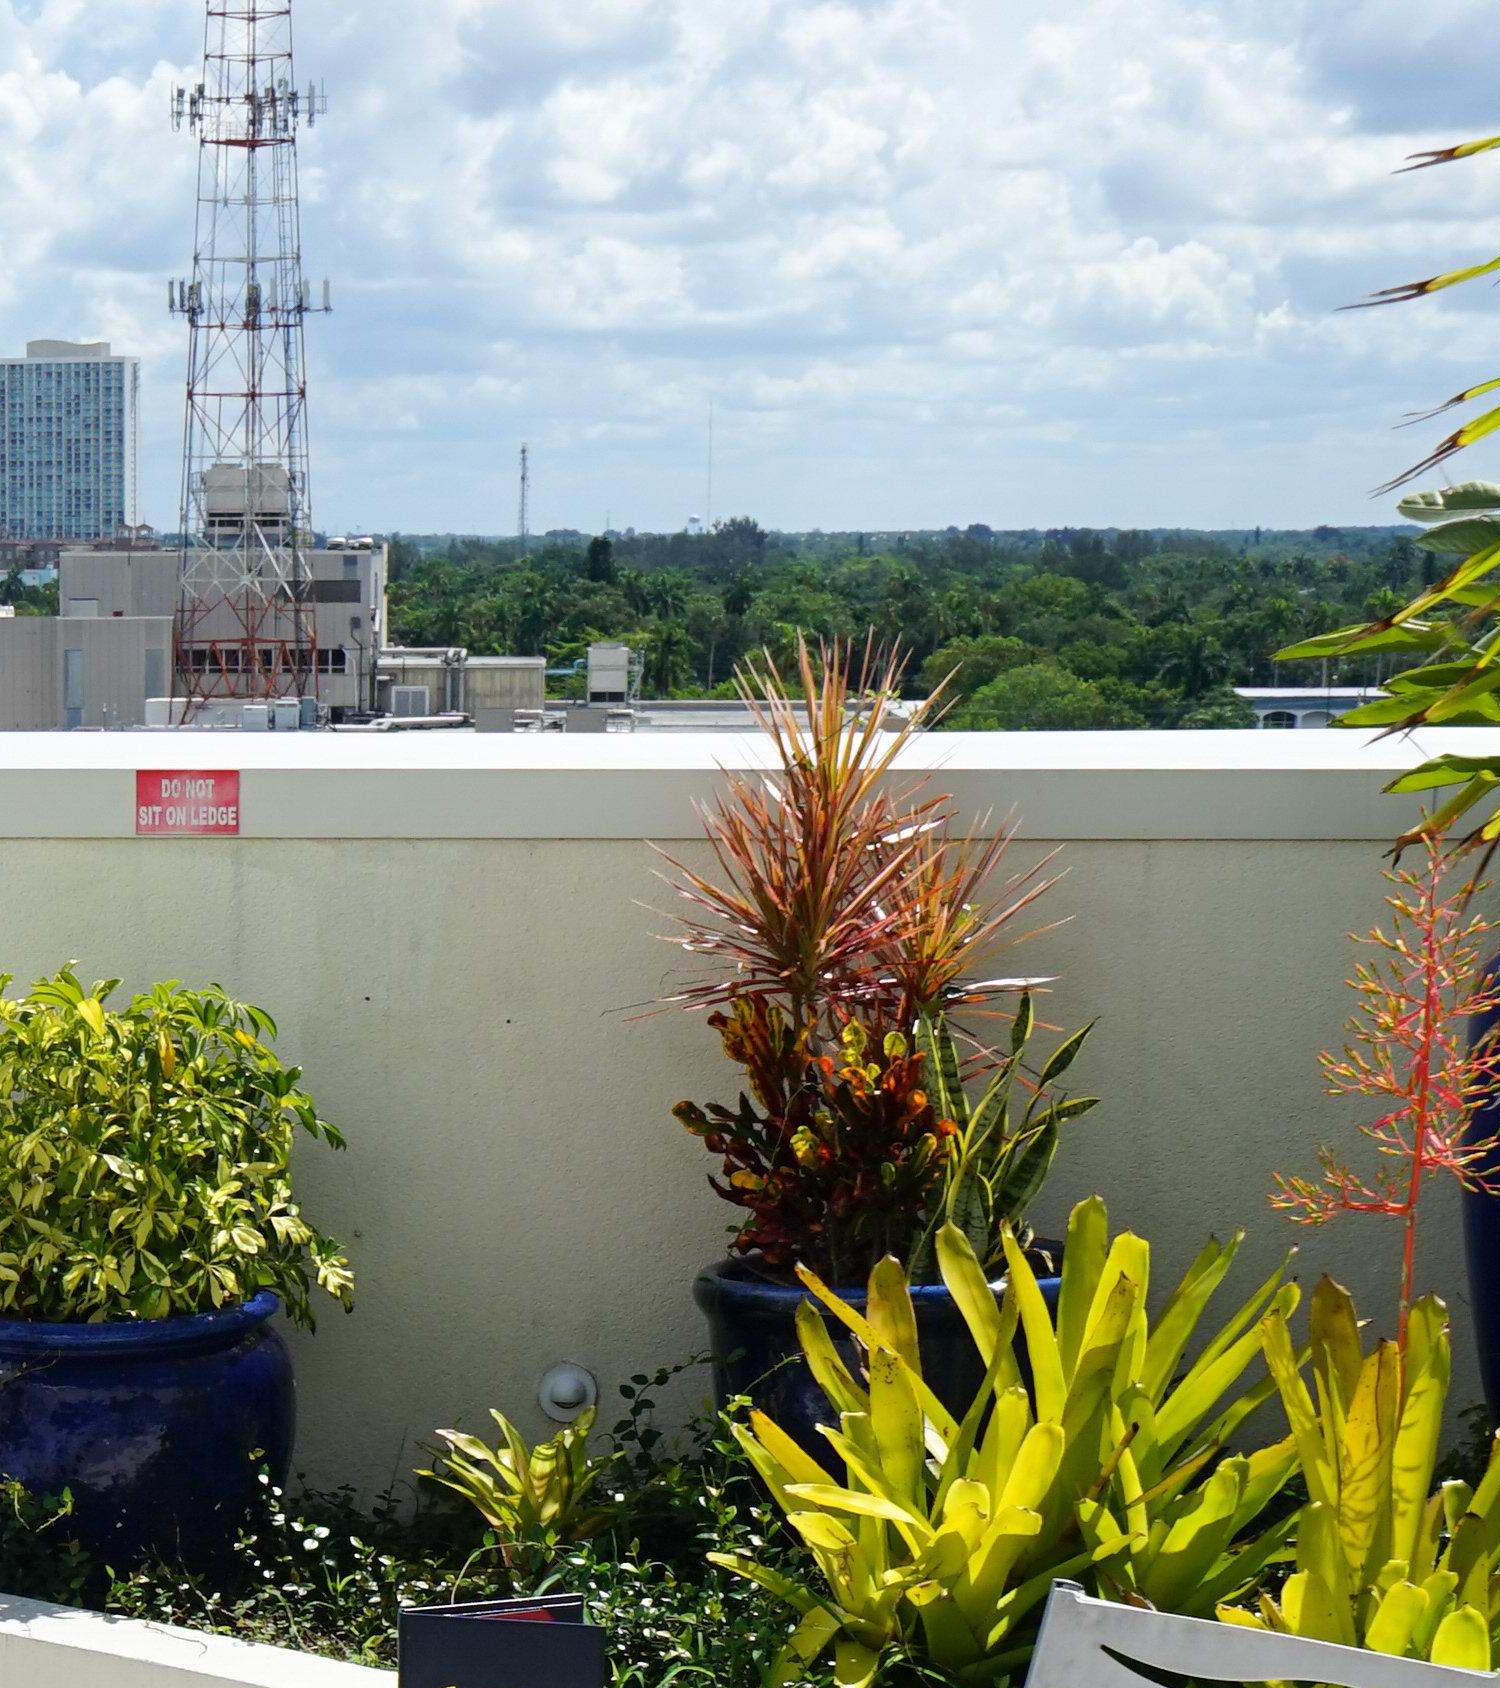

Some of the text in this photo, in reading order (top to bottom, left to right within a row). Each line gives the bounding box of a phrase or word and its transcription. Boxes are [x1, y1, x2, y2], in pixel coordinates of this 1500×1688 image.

[161, 779, 215, 798] DO NOT
[138, 806, 237, 826] SIT ON LEDGE
